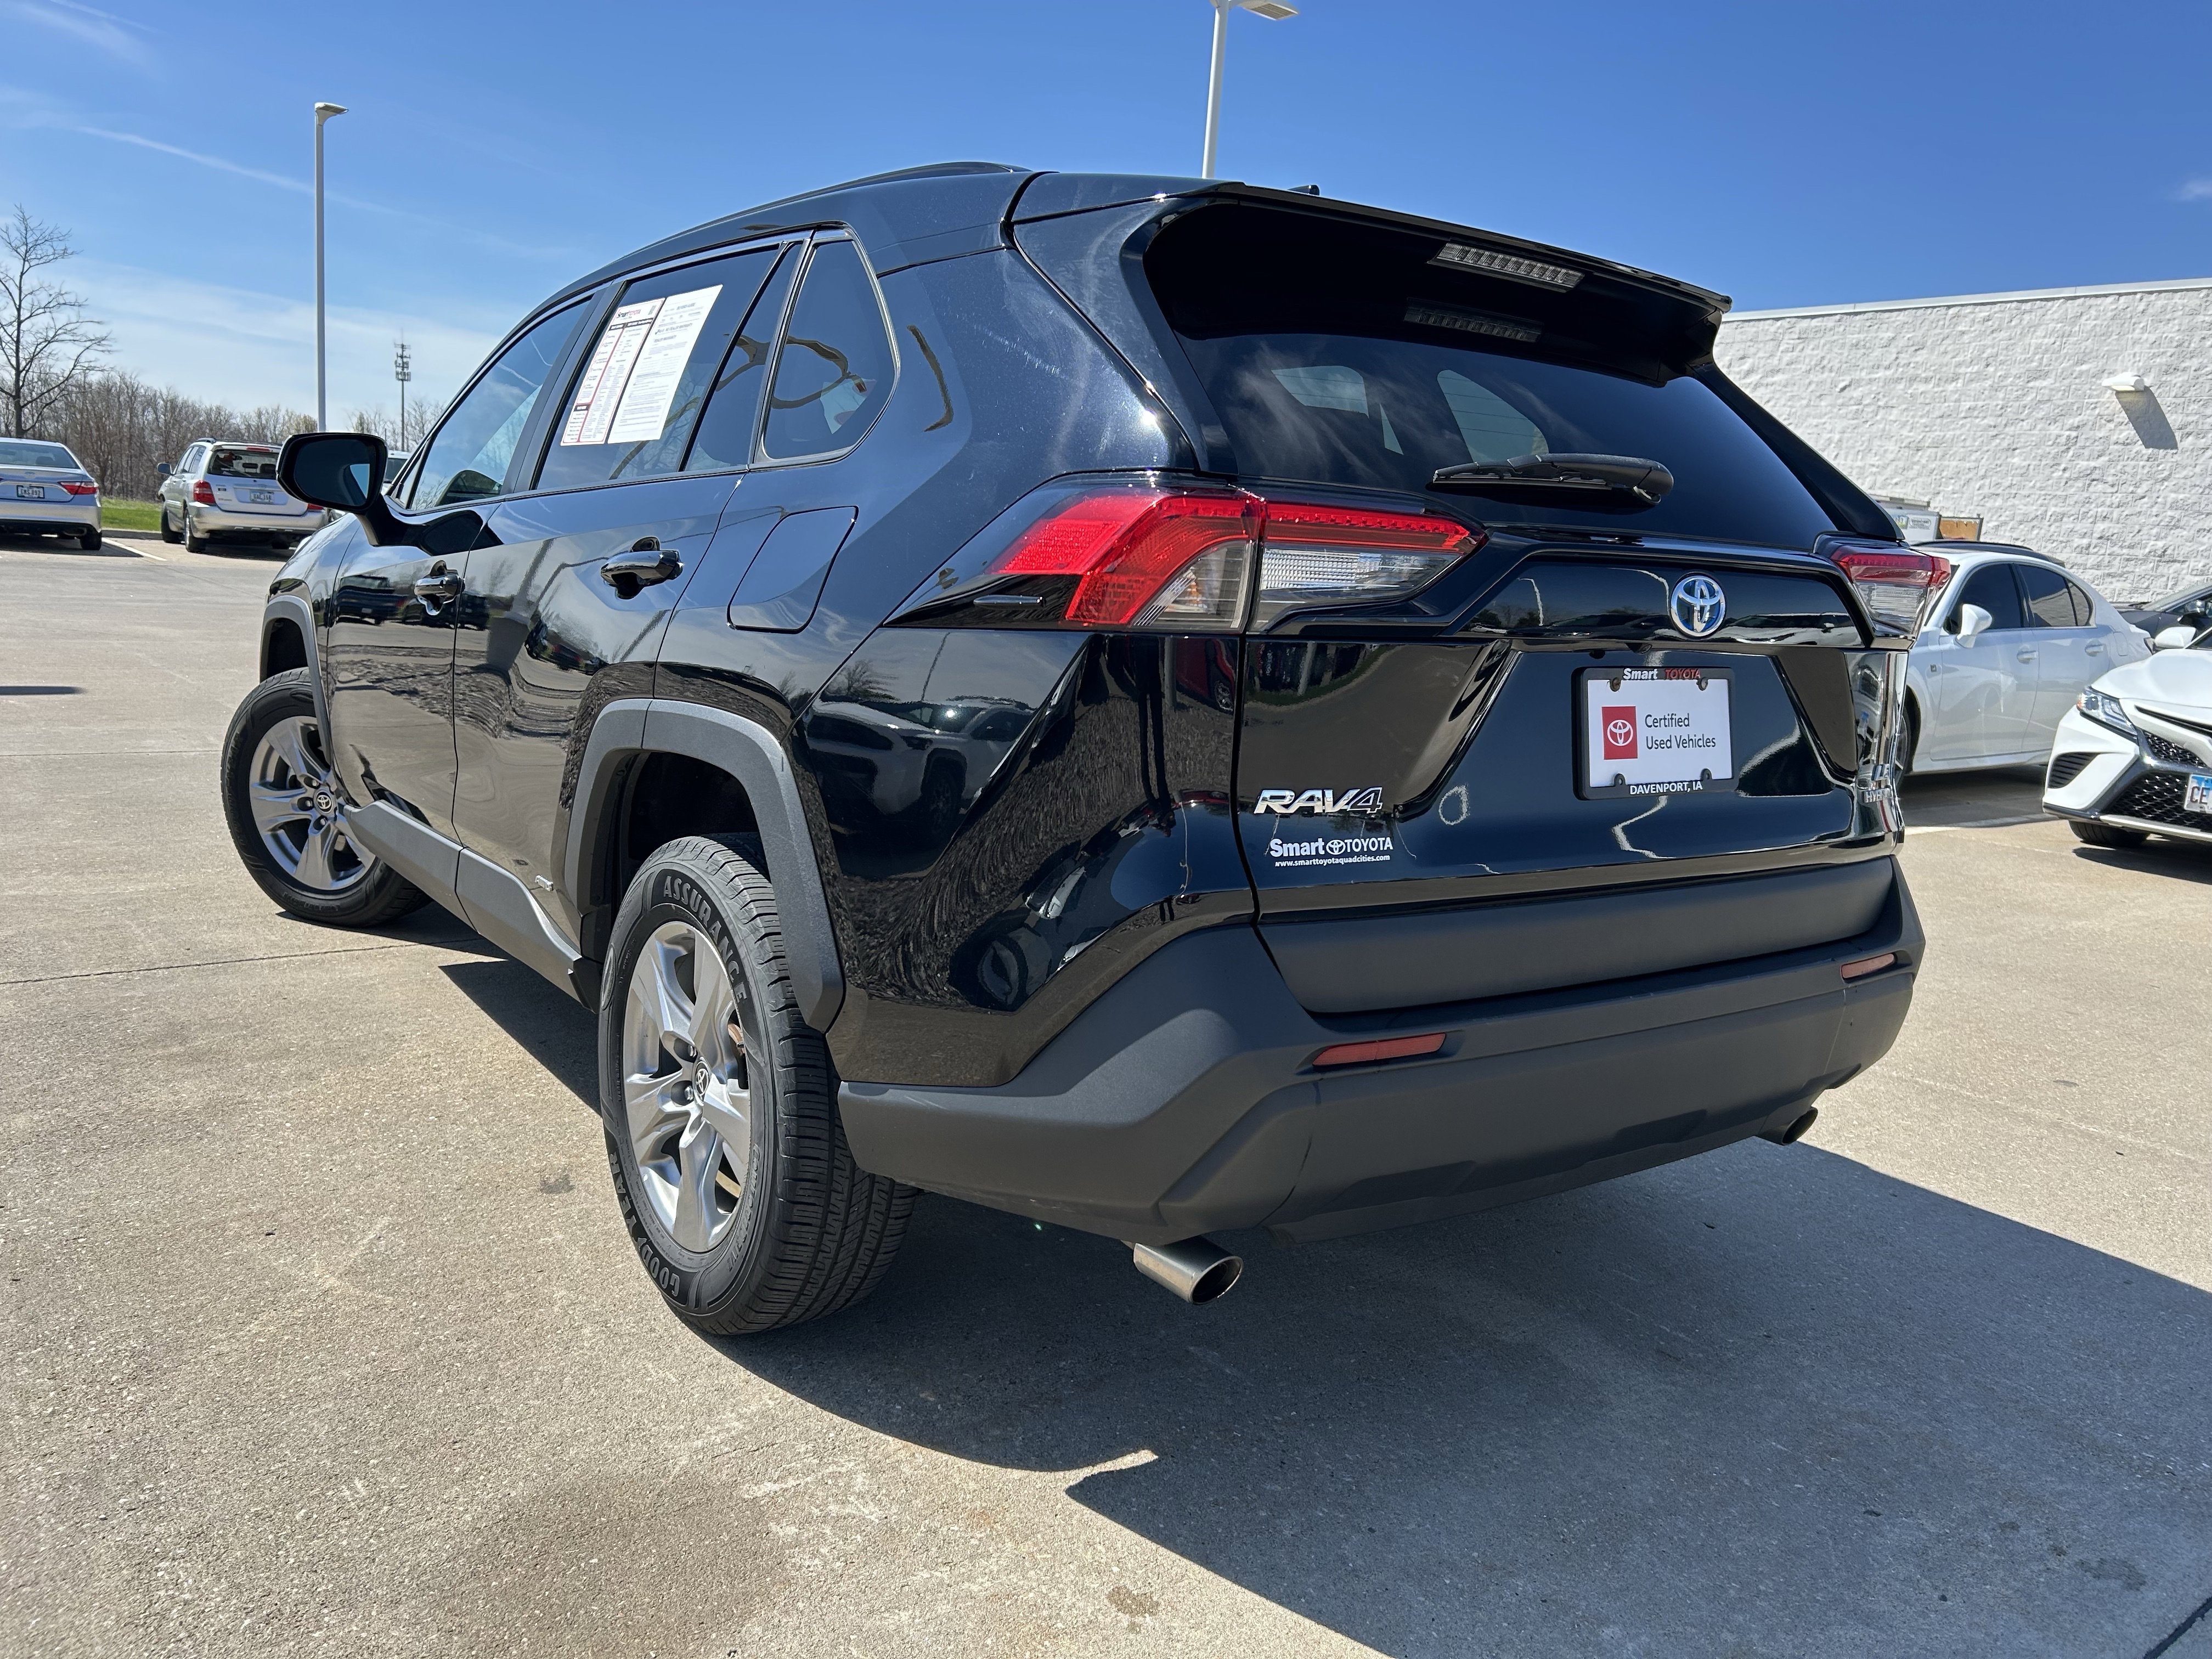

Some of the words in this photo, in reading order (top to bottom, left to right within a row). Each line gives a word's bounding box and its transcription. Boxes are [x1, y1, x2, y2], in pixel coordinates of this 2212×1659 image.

[1623, 668, 1658, 681] Smart
[1664, 668, 1701, 680] TOYOTA
[1645, 713, 1690, 728] Certified
[1646, 735, 1673, 750] Used
[1674, 733, 1716, 749] Vehicles
[1630, 781, 1691, 795] DAVENPORT,
[1692, 781, 1703, 791] IA
[1254, 786, 1383, 815] RAV4
[1269, 837, 1325, 857] Smart
[1345, 837, 1393, 853] TOYOTA
[1274, 854, 1391, 867] www.smarttoyotaquadcities.com
[663, 876, 748, 1003] ASSURANCE
[609, 1152, 680, 1297] GOODYEAR
